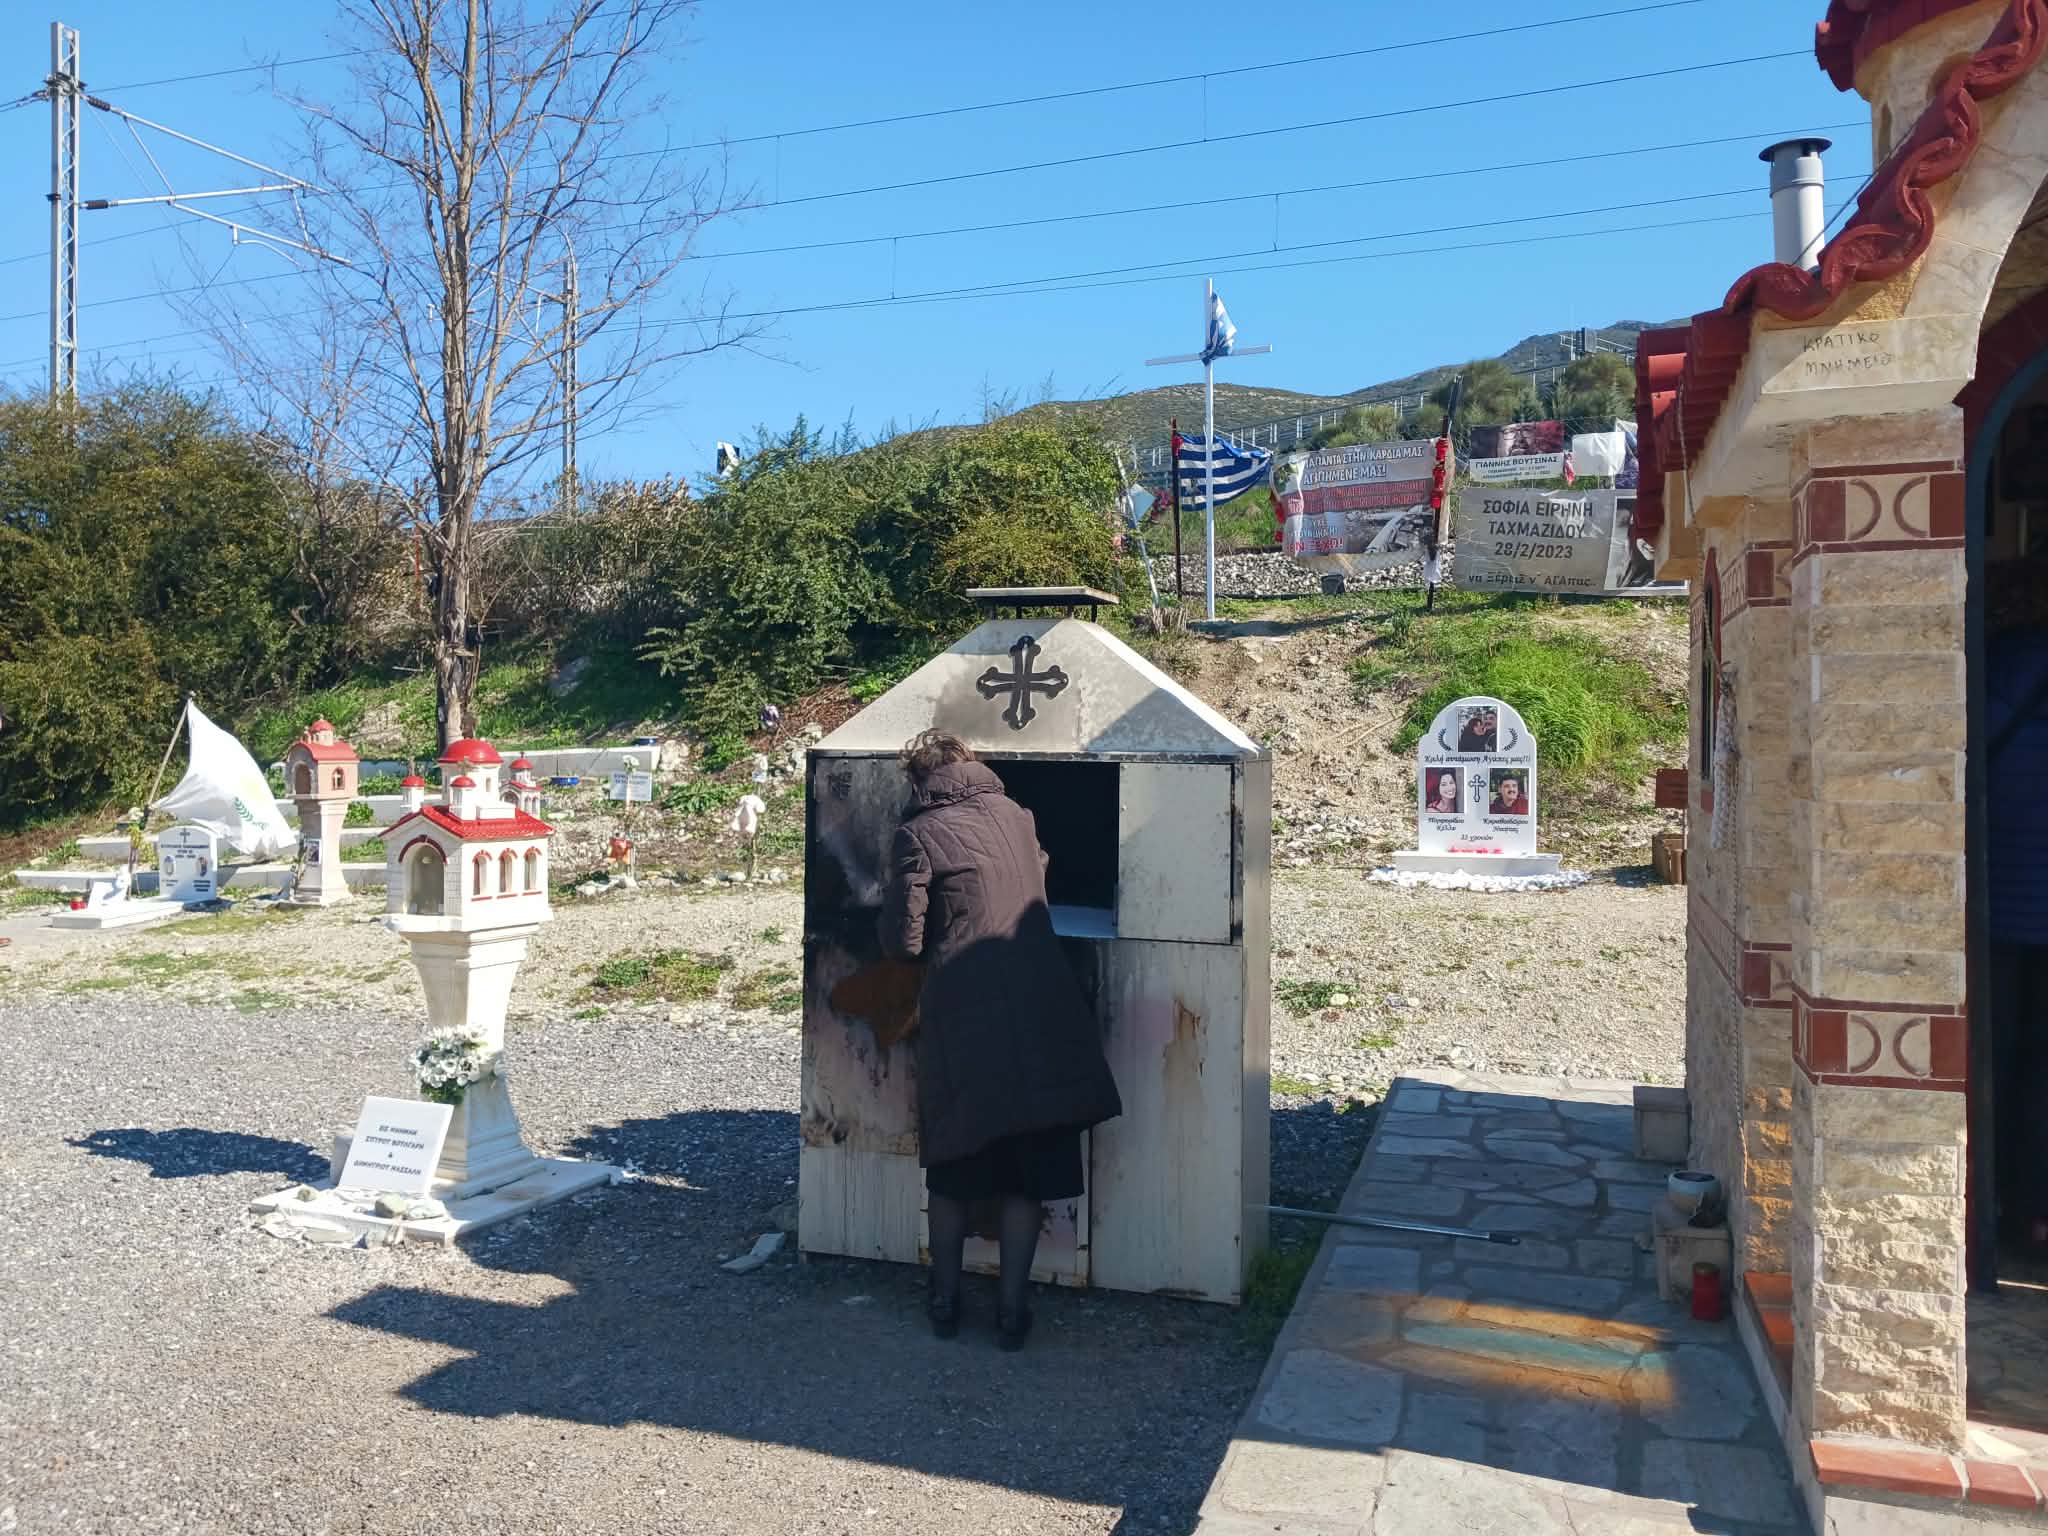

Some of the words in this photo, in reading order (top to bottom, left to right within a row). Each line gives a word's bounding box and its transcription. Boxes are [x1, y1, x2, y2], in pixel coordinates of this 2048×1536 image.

[1369, 448, 1402, 461] ΚΑΡΔΙΑ
[1403, 446, 1423, 457] ΜΑΣ
[1482, 499, 1530, 515] ΣΟΦΙΑ
[1535, 500, 1593, 517] ΕΙΡΗΝΗ
[1488, 520, 1585, 539] ΤΑΧΜΑΖΙΔΟΥ
[1494, 541, 1574, 560] 28/2/2023
